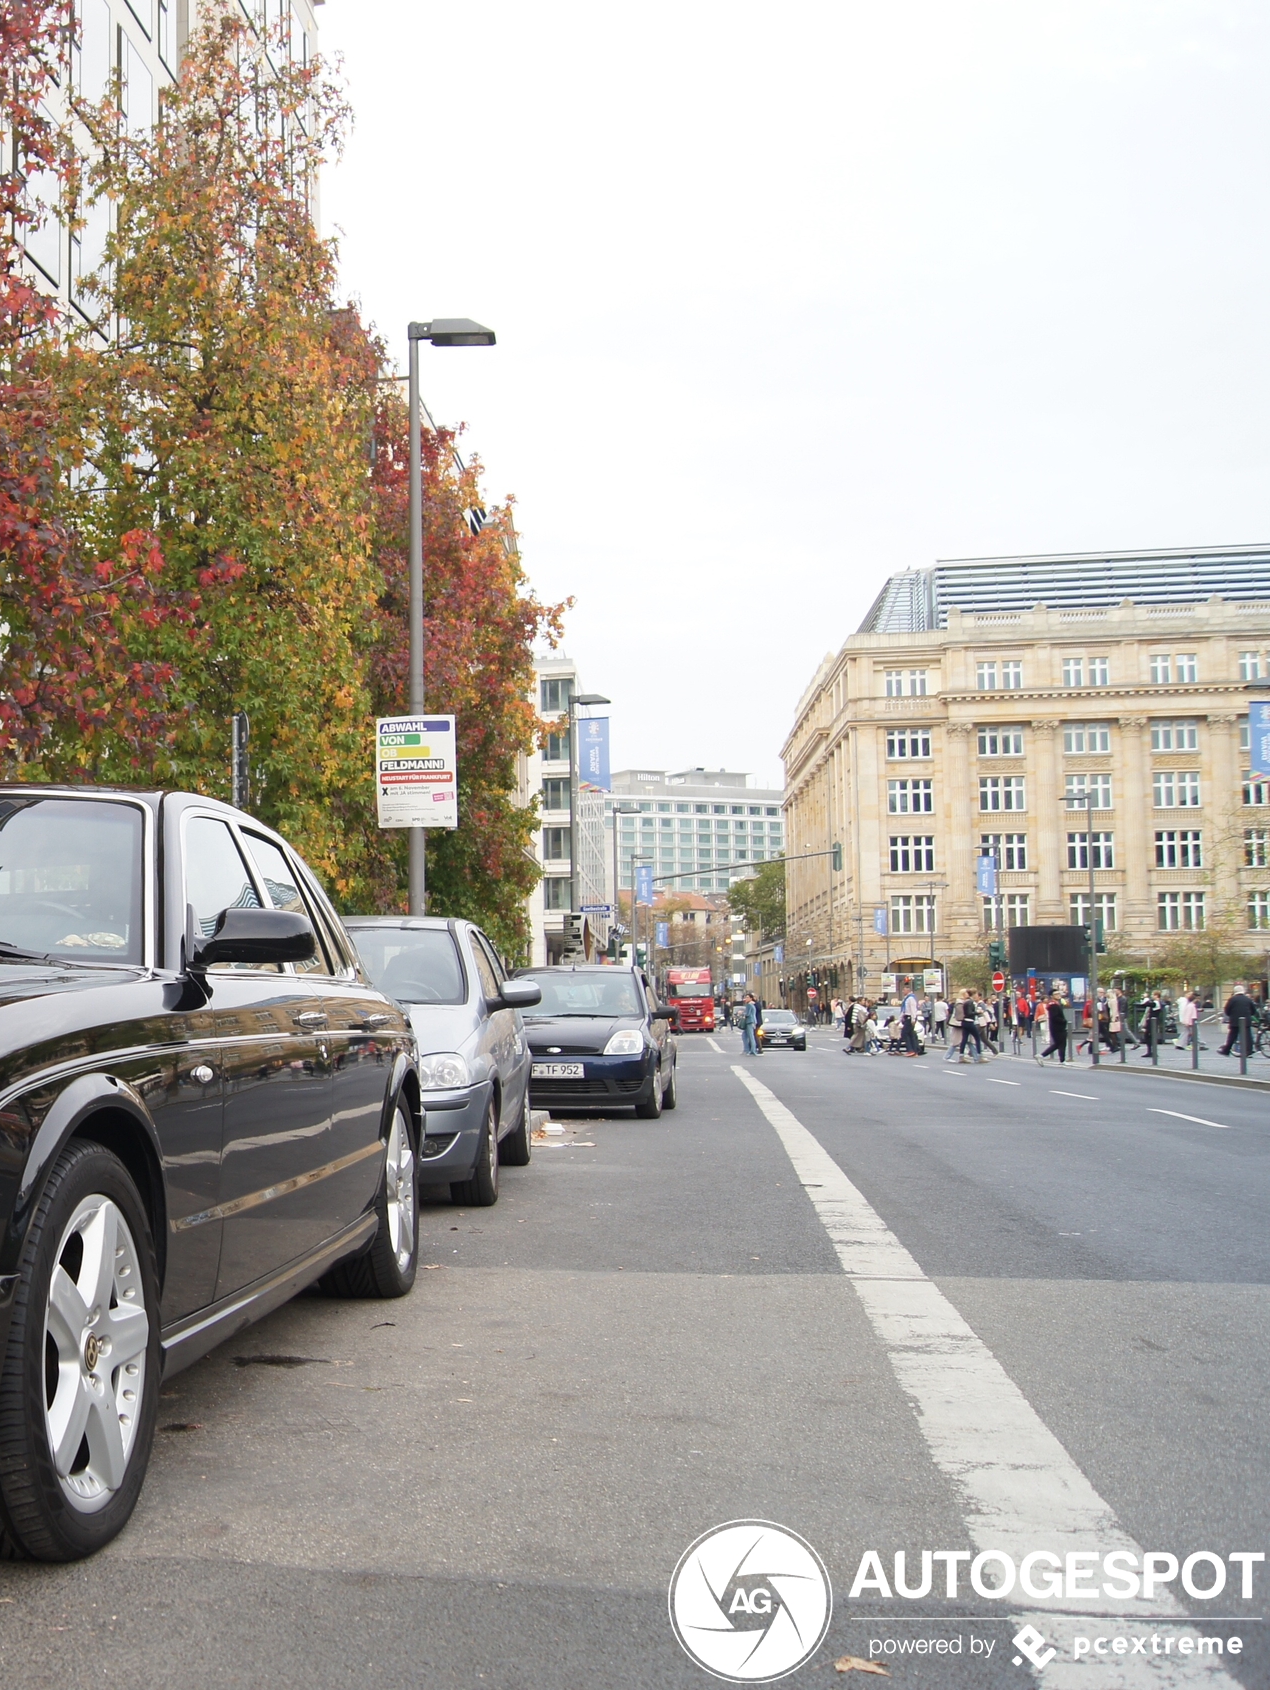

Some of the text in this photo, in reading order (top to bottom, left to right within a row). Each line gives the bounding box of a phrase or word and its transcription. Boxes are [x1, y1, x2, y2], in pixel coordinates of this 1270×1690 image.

[381, 722, 427, 733] ABWAHL
[381, 735, 405, 746] VON
[381, 748, 397, 757] OB
[381, 760, 444, 771] FELDMANN!
[637, 773, 660, 781] Hilton
[532, 1065, 579, 1075] F TF 952
